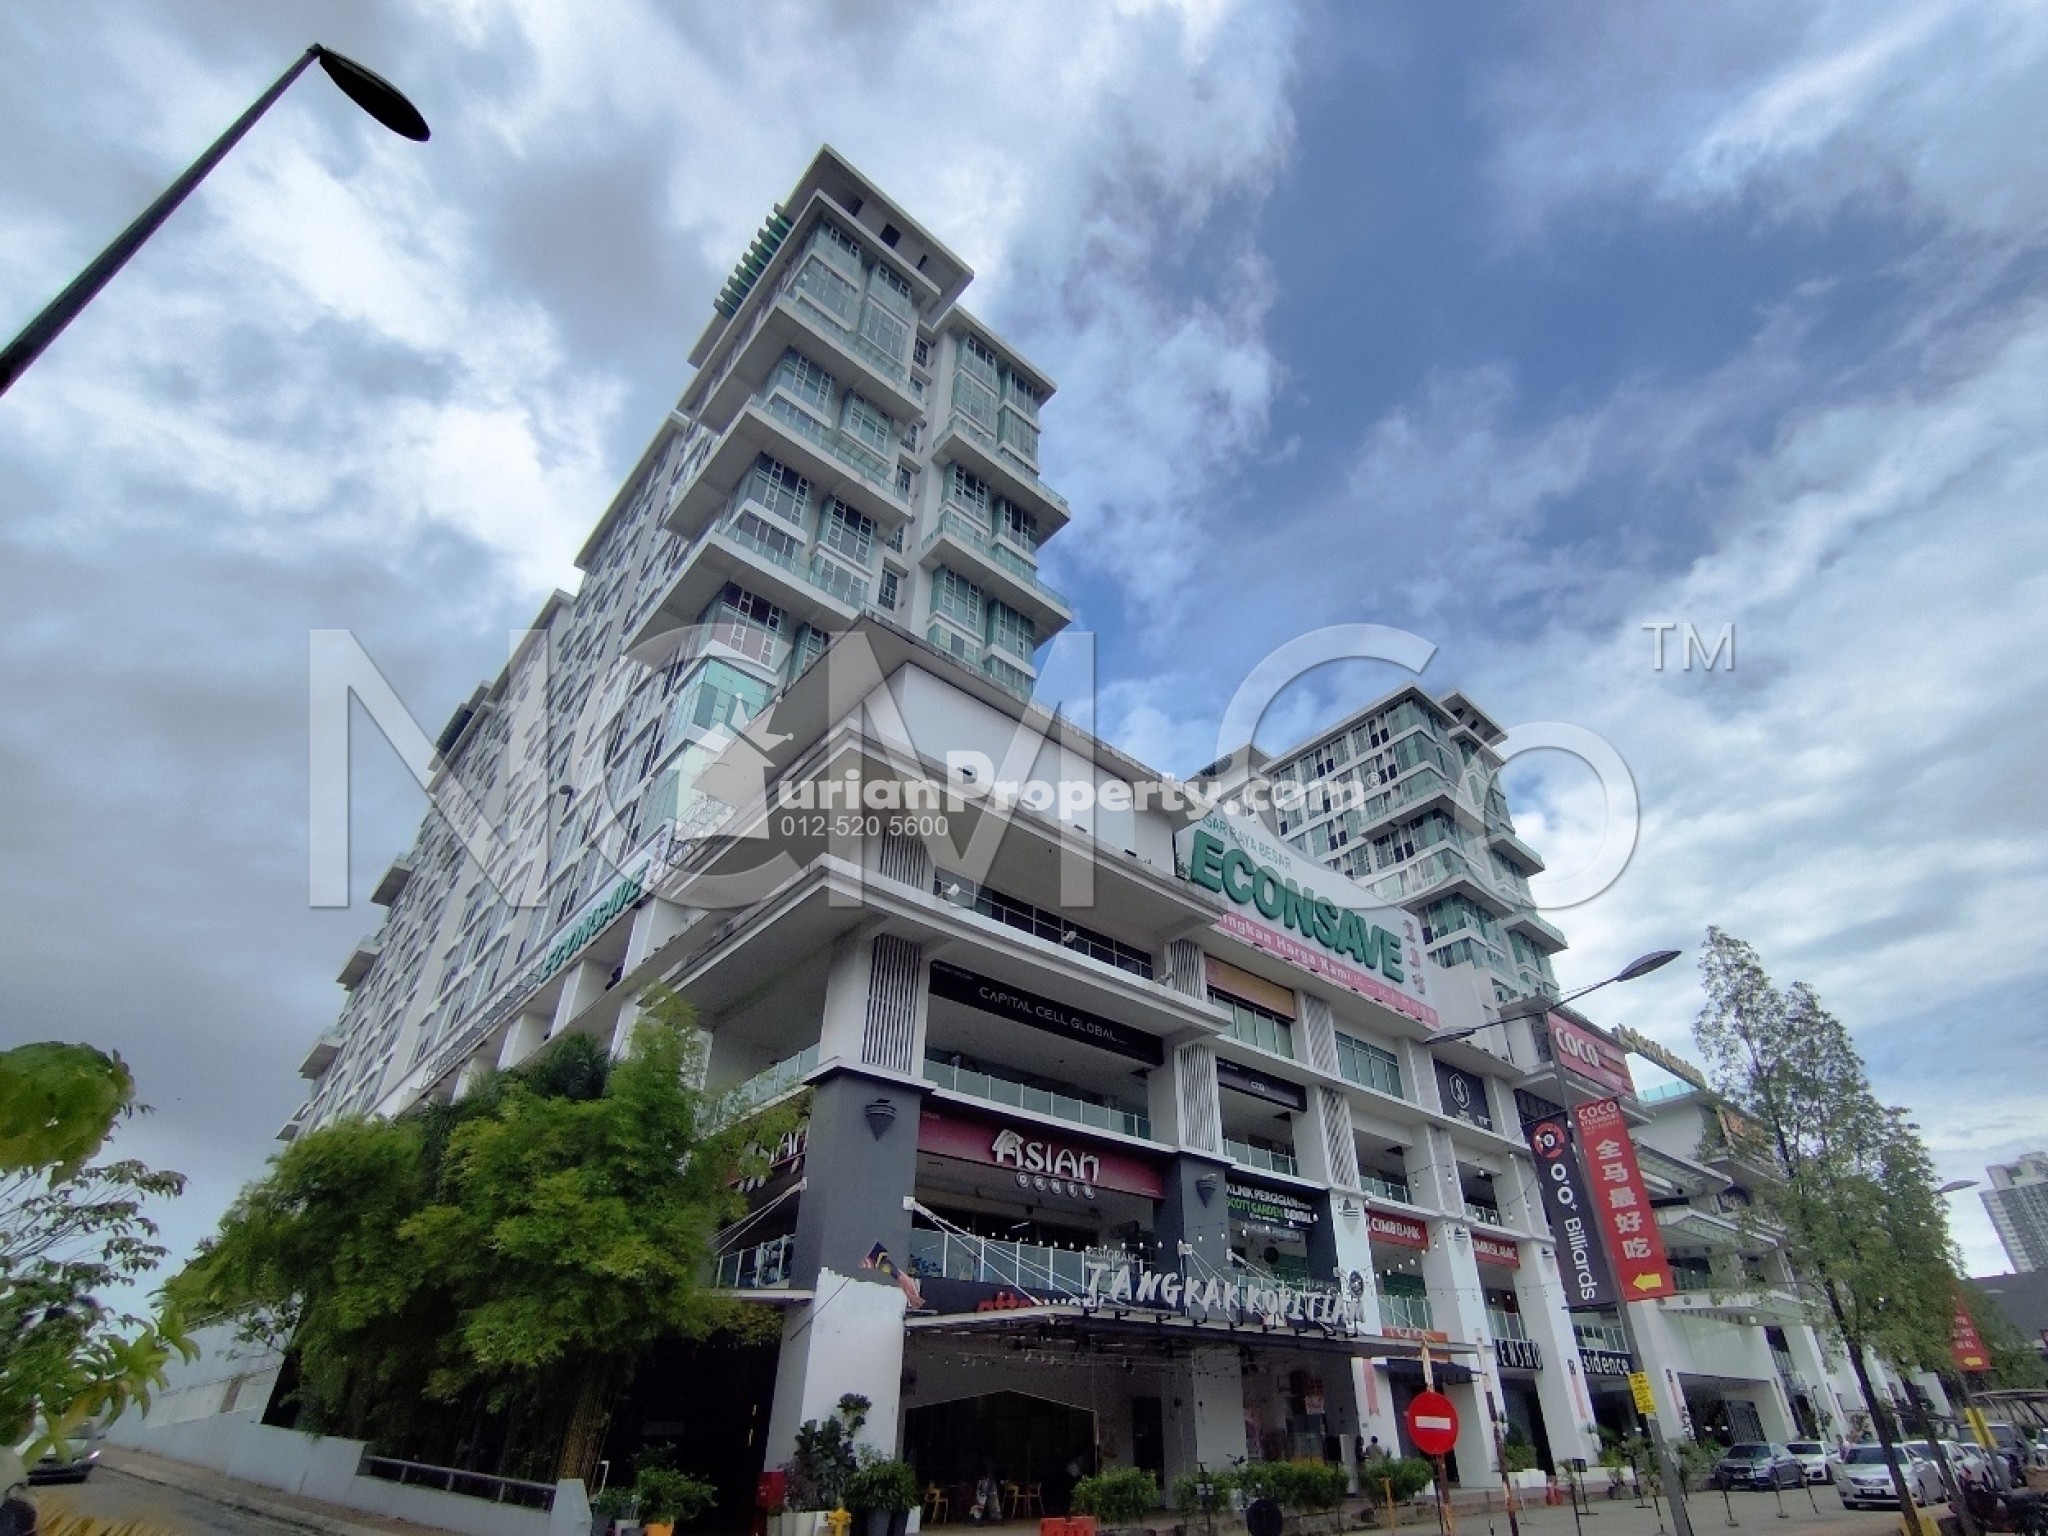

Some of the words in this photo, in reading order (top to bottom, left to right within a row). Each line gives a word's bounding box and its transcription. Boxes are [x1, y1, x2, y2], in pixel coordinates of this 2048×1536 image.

[1190, 829, 1404, 983] ECONSAVE
[1276, 935, 1316, 965] Harga
[1320, 956, 1351, 980] Kami
[978, 986, 1033, 1015] CAPITAL
[1035, 1005, 1068, 1026] CELL
[1070, 1017, 1118, 1042] GLOBAL
[1555, 1027, 1600, 1068] COCO
[1578, 1101, 1618, 1120] COCO
[1563, 1216, 1598, 1301] Billiards
[1084, 1261, 1240, 1315] TANGKAK
